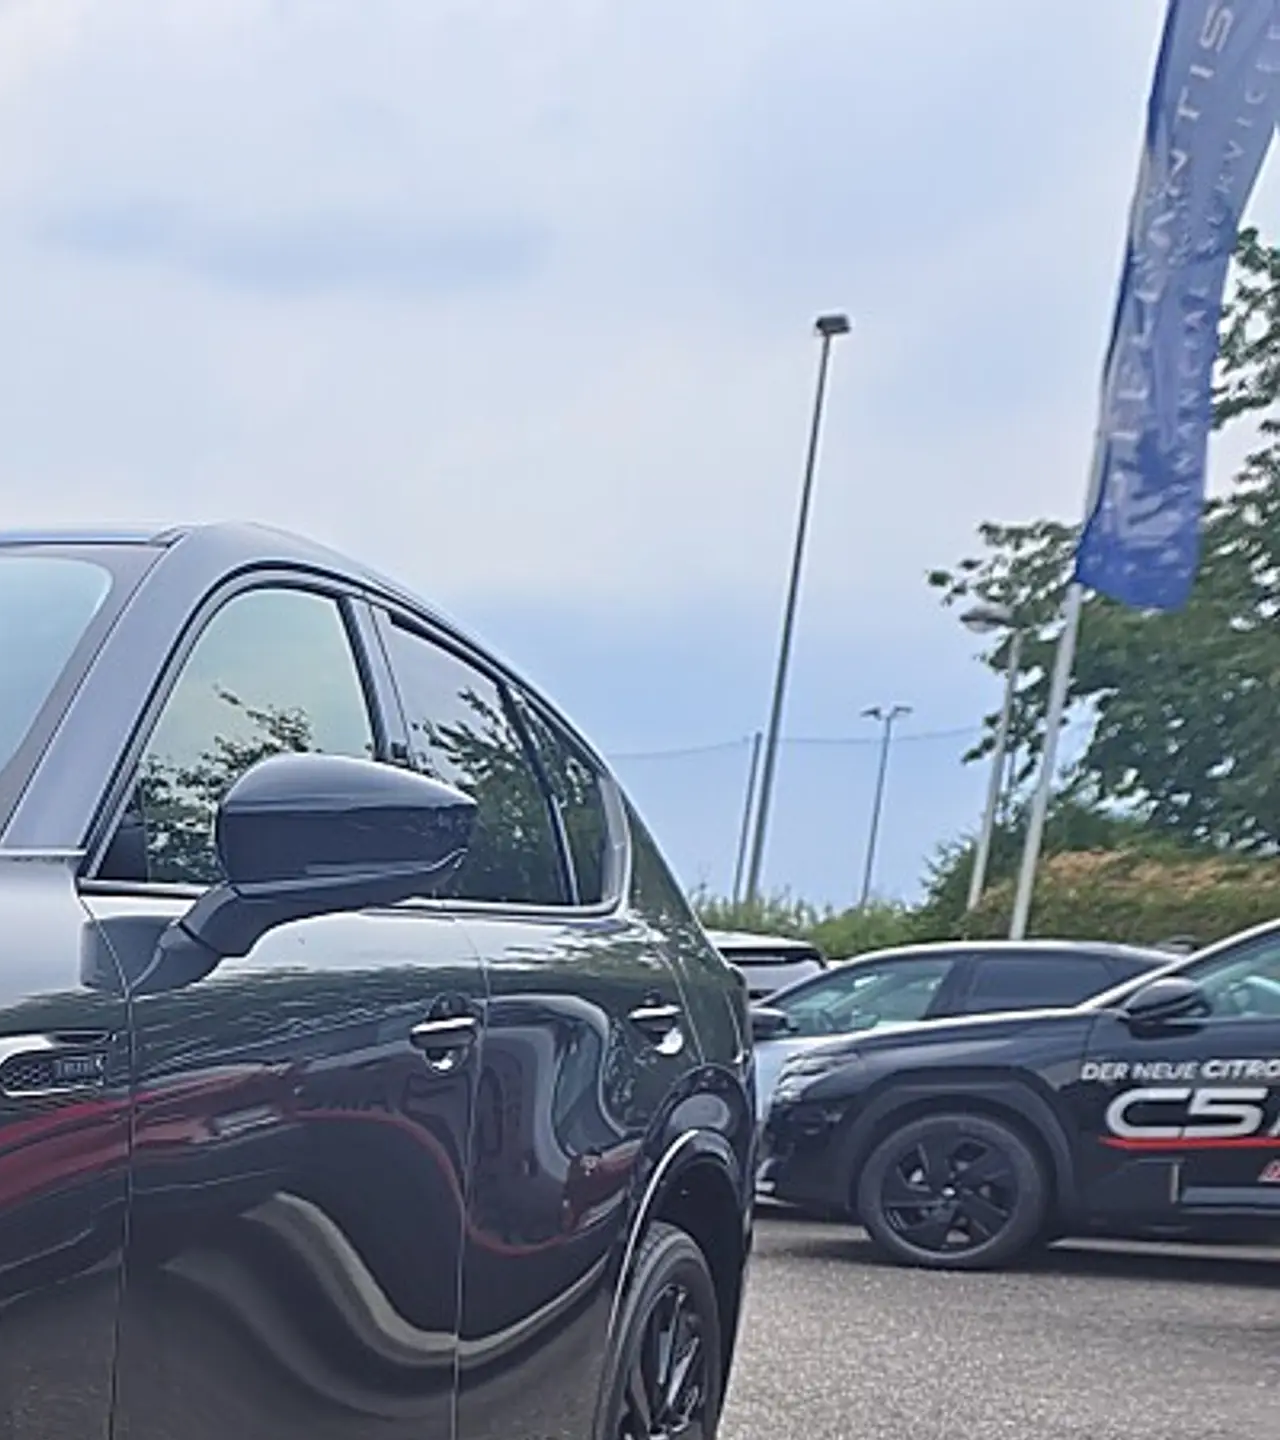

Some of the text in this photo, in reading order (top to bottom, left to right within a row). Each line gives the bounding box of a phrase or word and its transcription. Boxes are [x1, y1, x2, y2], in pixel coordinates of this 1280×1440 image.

[1080, 1061, 1130, 1081] DER
[1132, 1060, 1200, 1080] NEUE
[1105, 1086, 1270, 1138] C5
